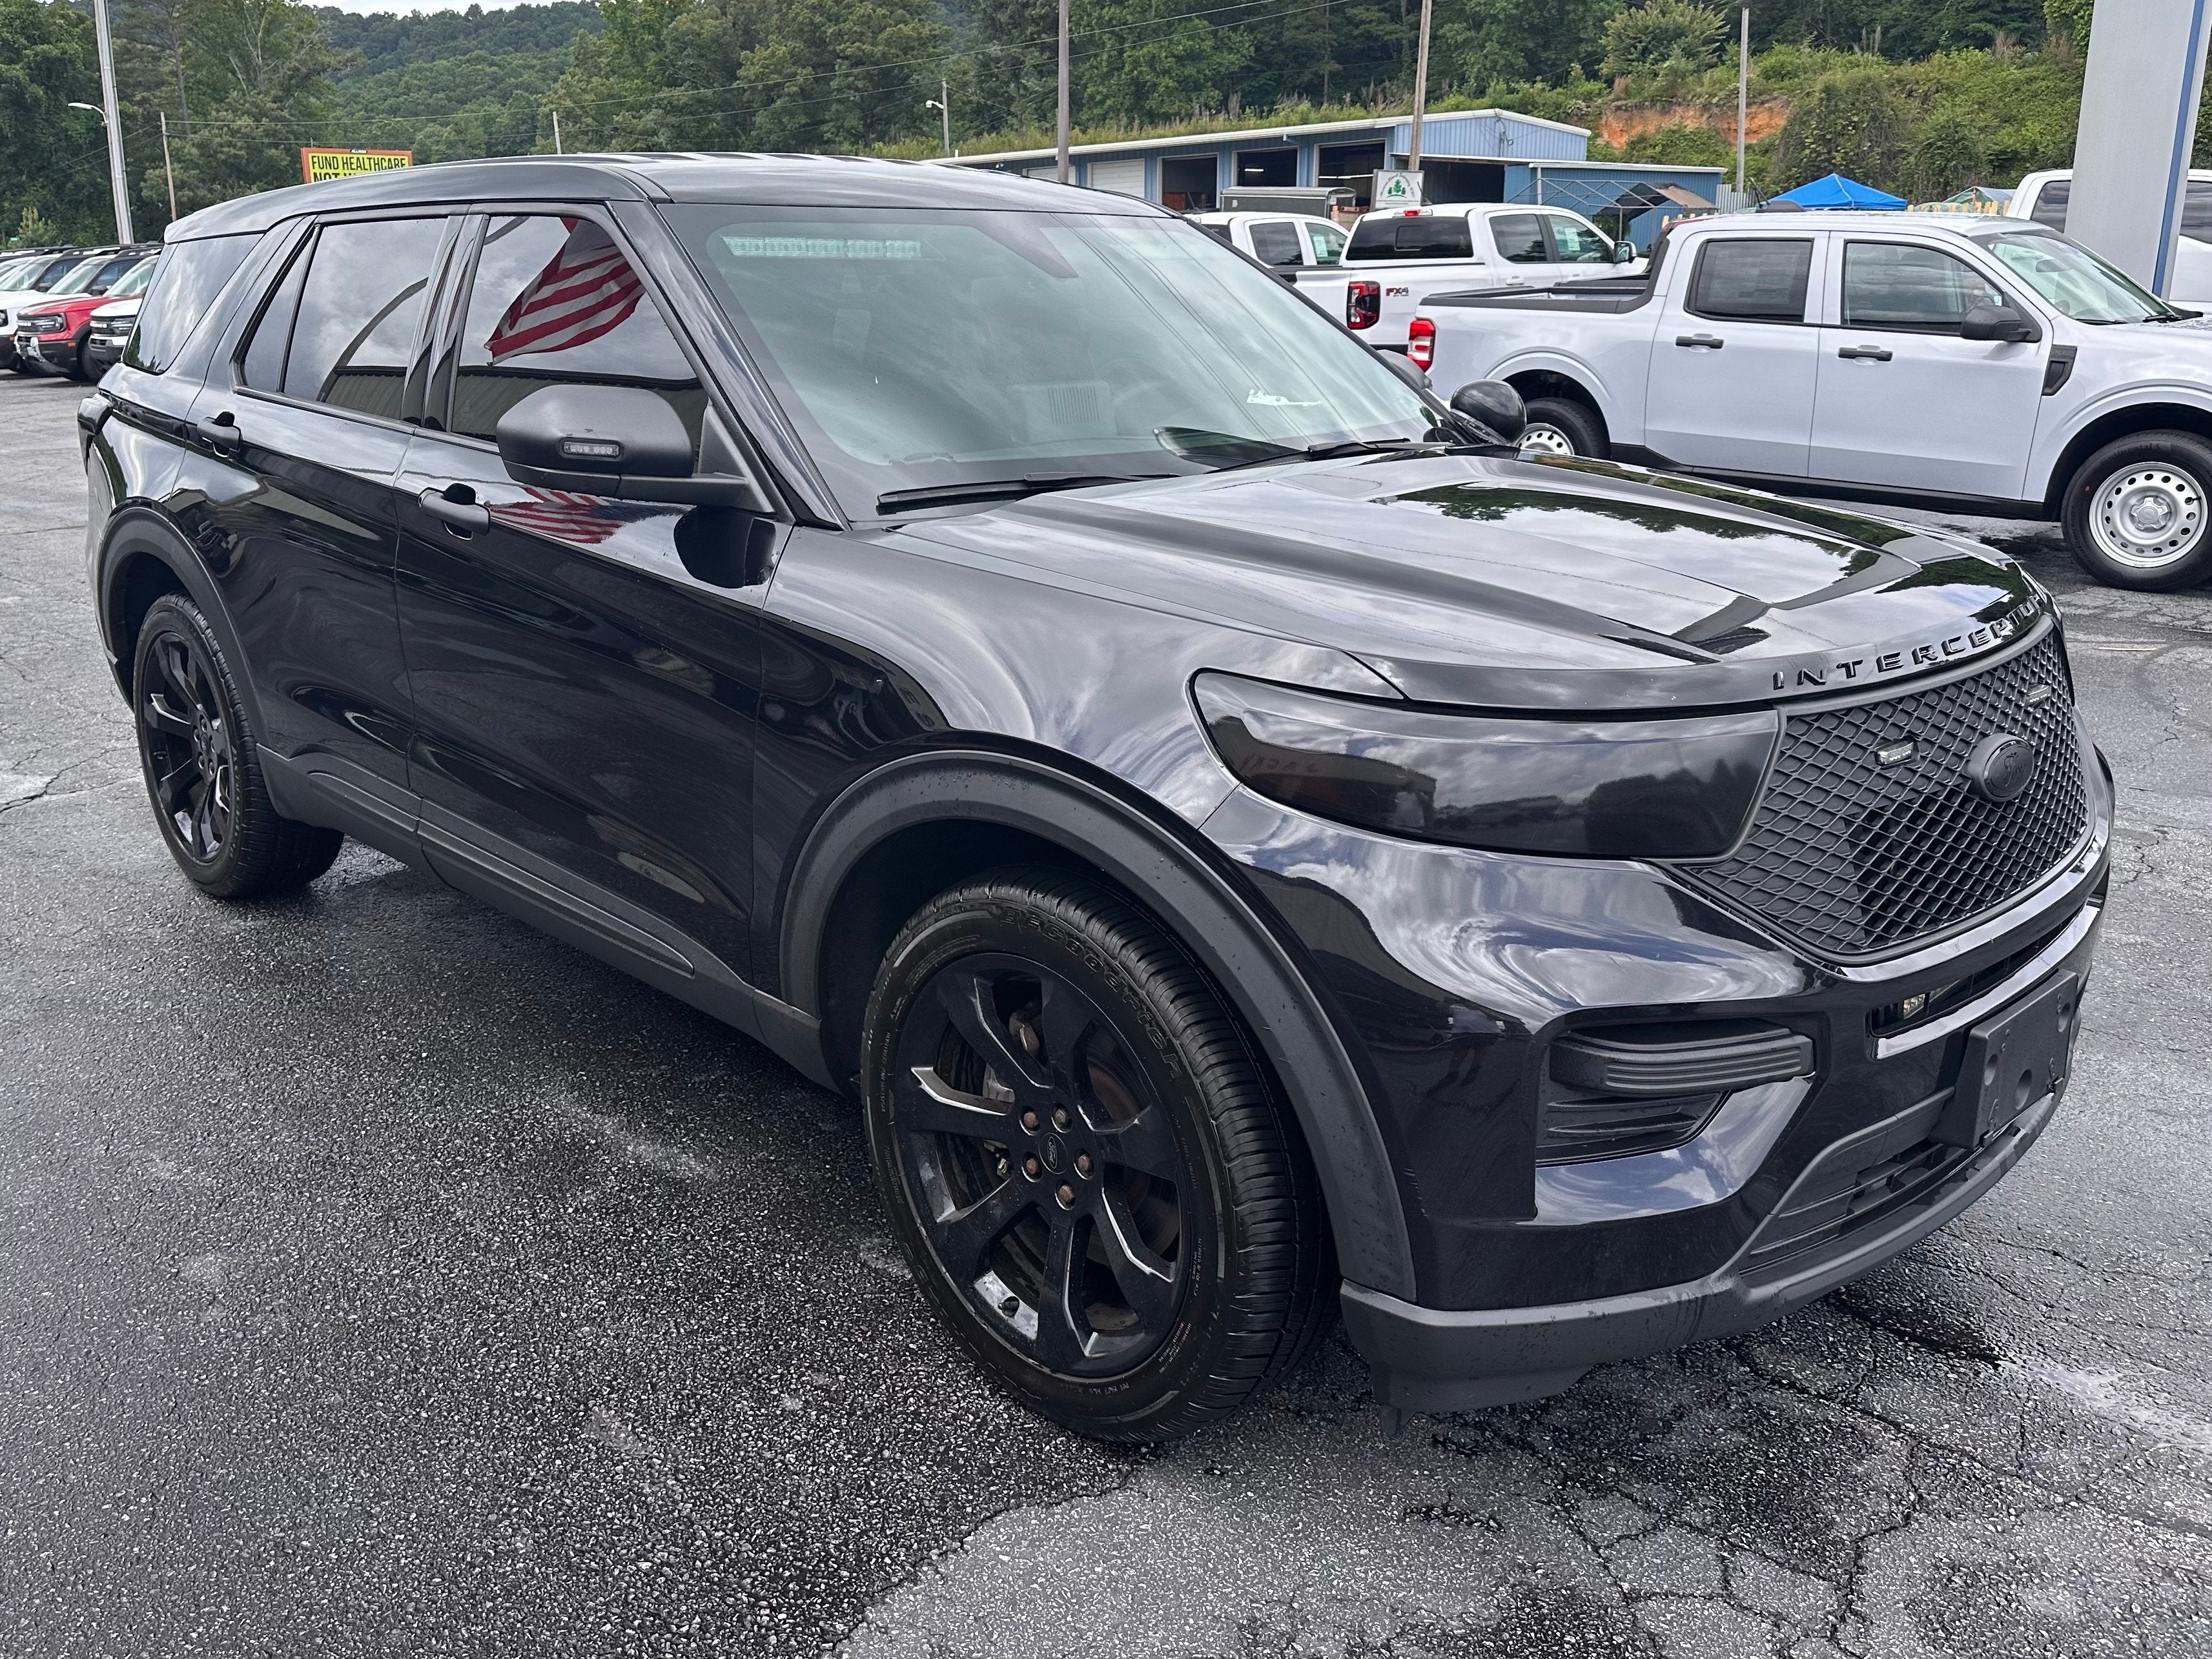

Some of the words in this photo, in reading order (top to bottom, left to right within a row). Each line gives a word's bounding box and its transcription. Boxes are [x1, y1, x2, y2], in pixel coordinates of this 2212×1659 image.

[311, 156, 339, 170] FUND
[342, 156, 406, 171] HEALTHCARE
[1386, 287, 1409, 296] FX4
[1773, 593, 2043, 690] INTERCEPTOR
[999, 904, 1182, 1079] BFGoodrich
